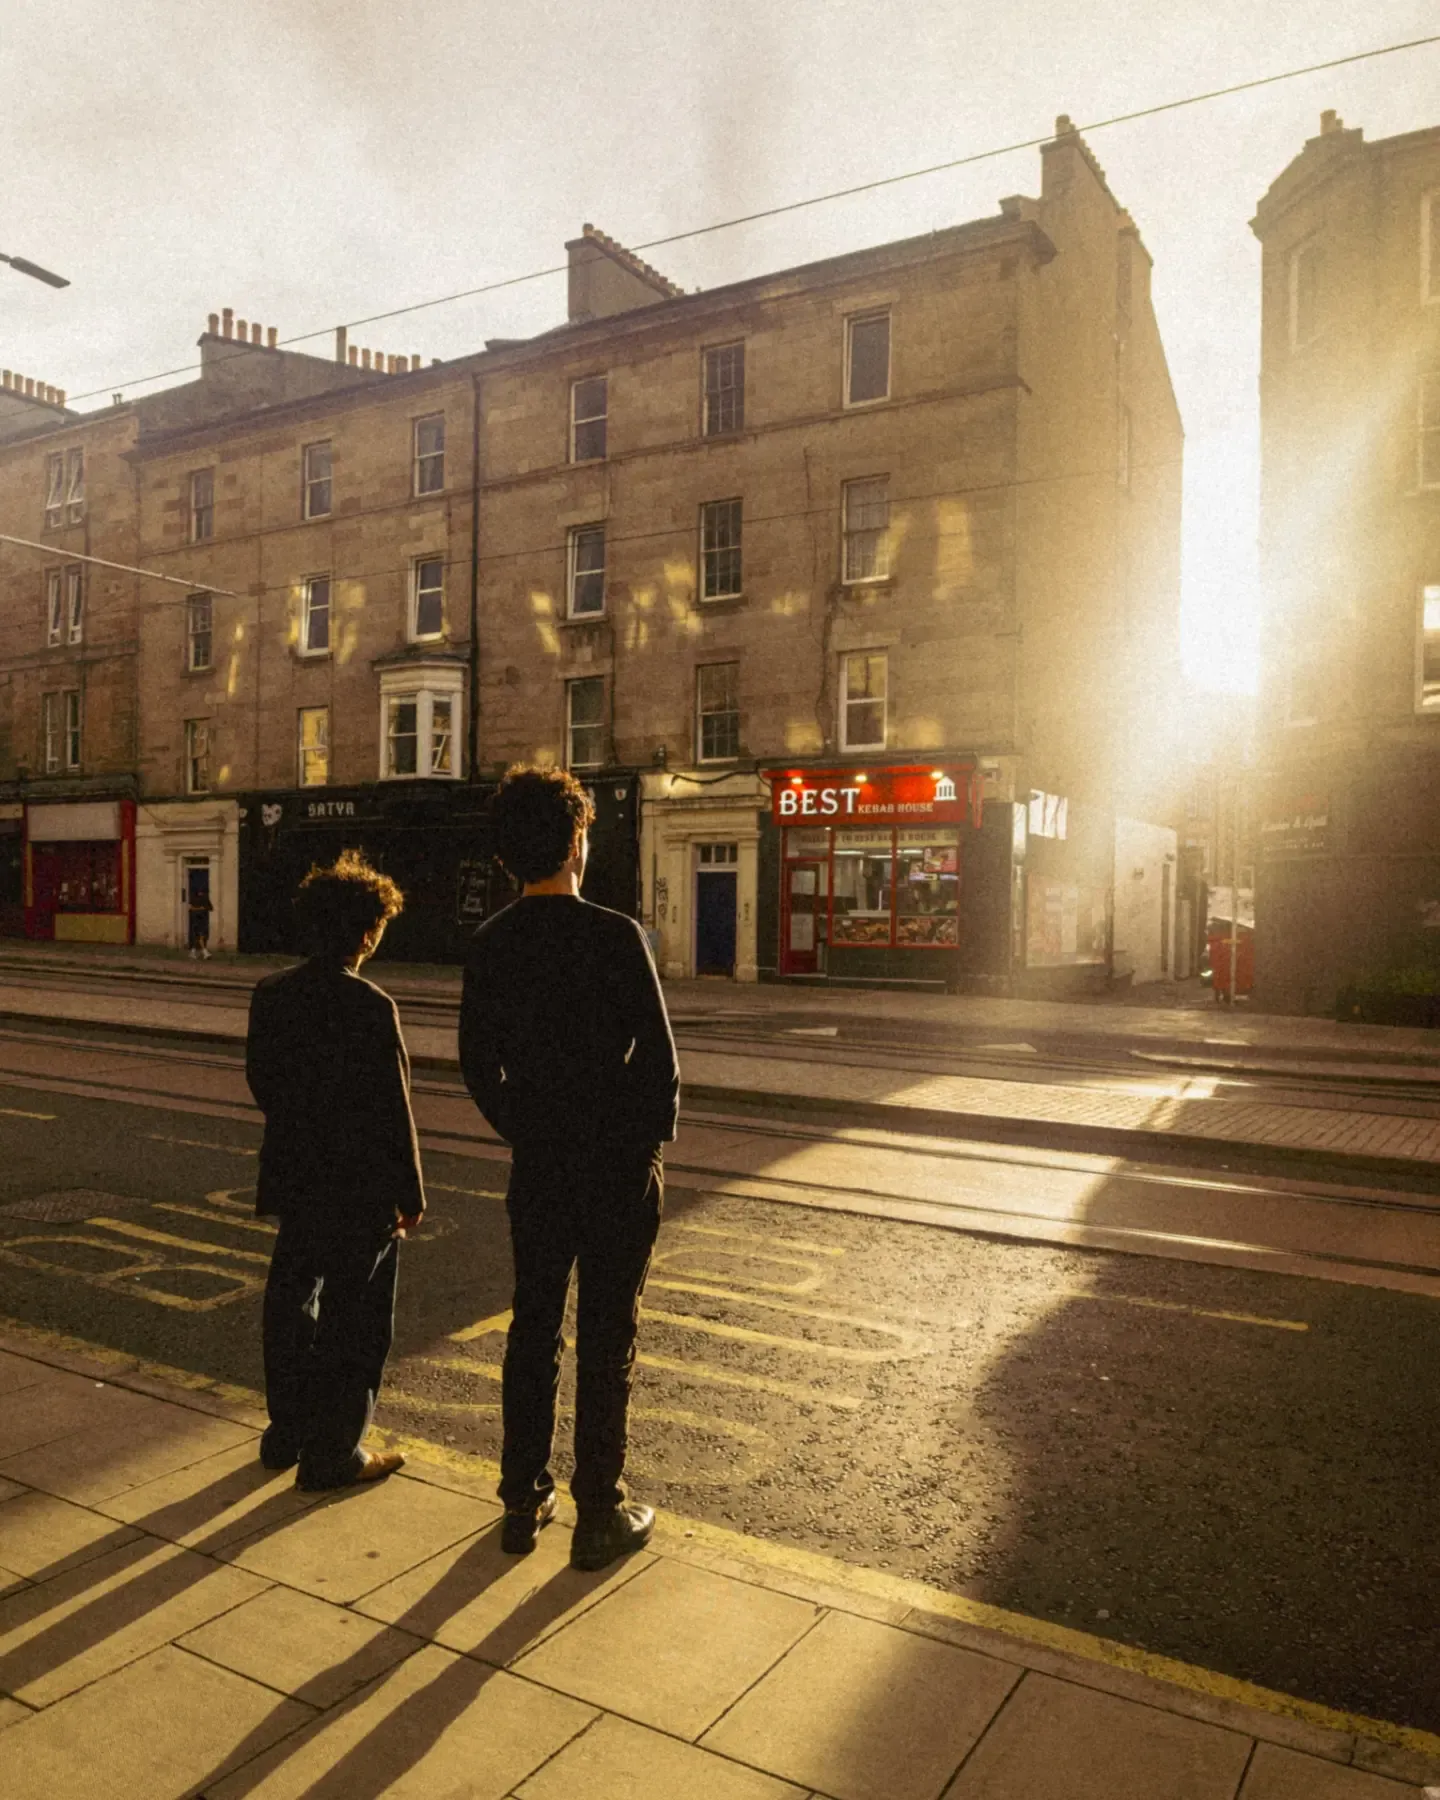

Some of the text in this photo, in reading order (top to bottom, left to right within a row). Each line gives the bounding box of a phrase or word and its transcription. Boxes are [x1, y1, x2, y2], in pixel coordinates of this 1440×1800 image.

[308, 801, 355, 818] SATYR
[779, 788, 934, 815] BEST KEBAB HOUSE
